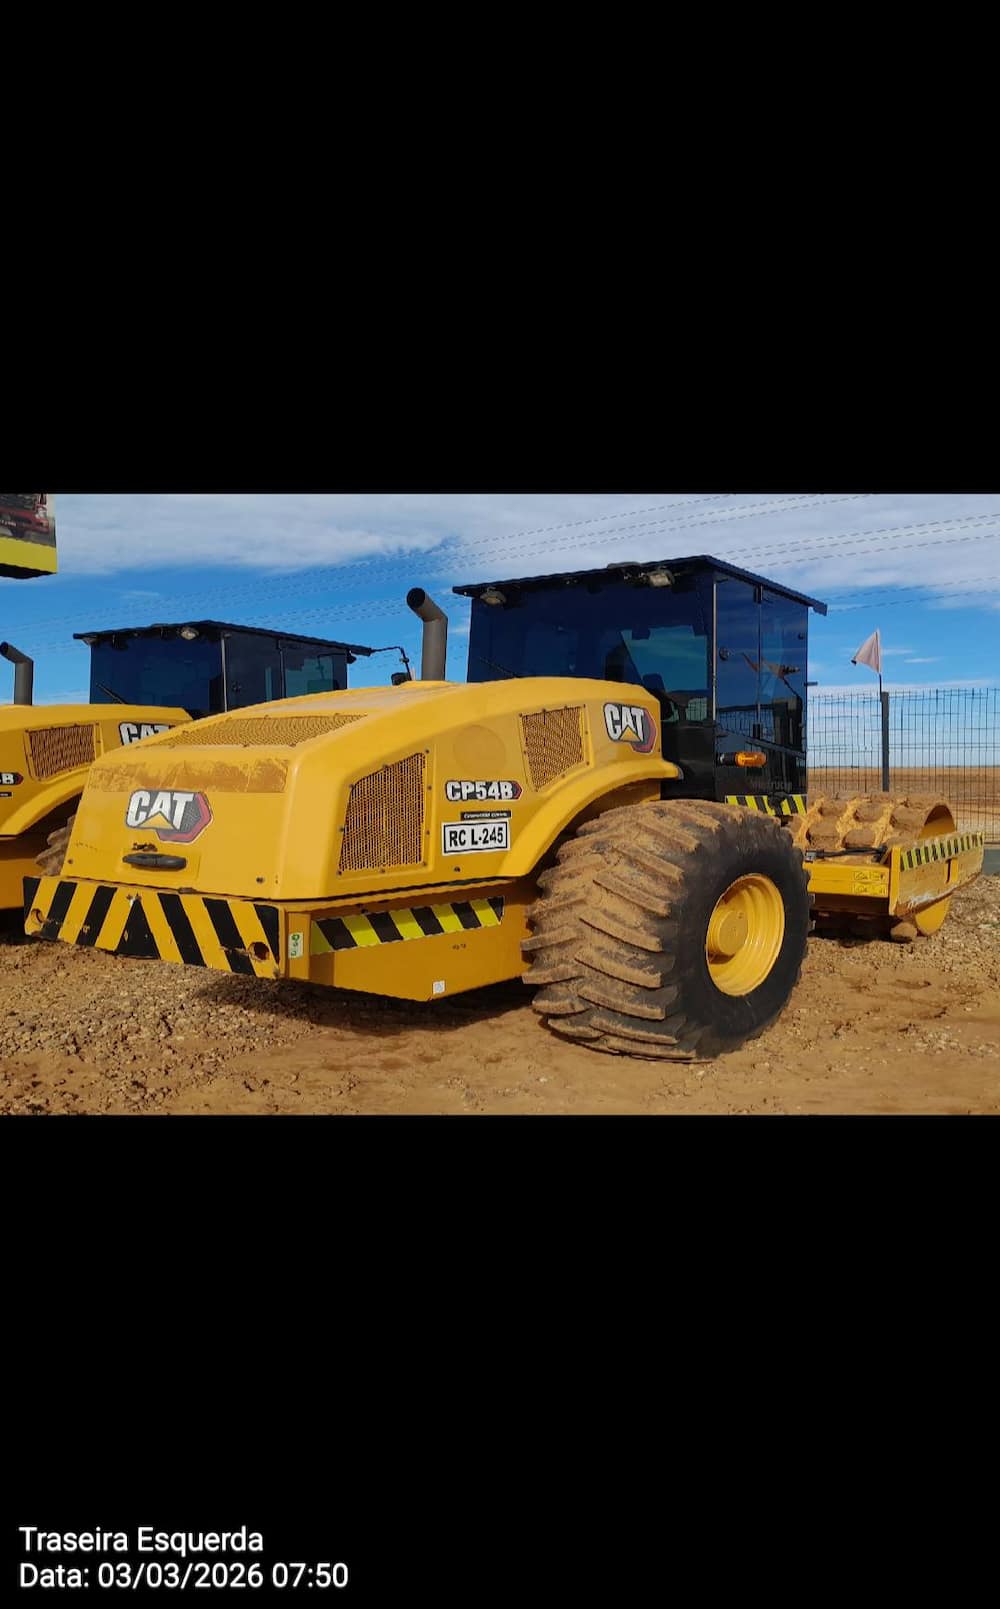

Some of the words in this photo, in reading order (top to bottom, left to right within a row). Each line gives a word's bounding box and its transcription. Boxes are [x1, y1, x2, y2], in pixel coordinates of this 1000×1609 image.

[604, 703, 644, 742] CAT
[446, 780, 513, 800] CP54B
[126, 790, 194, 830] CAT
[449, 829, 466, 847] RC
[471, 827, 503, 846] L-245
